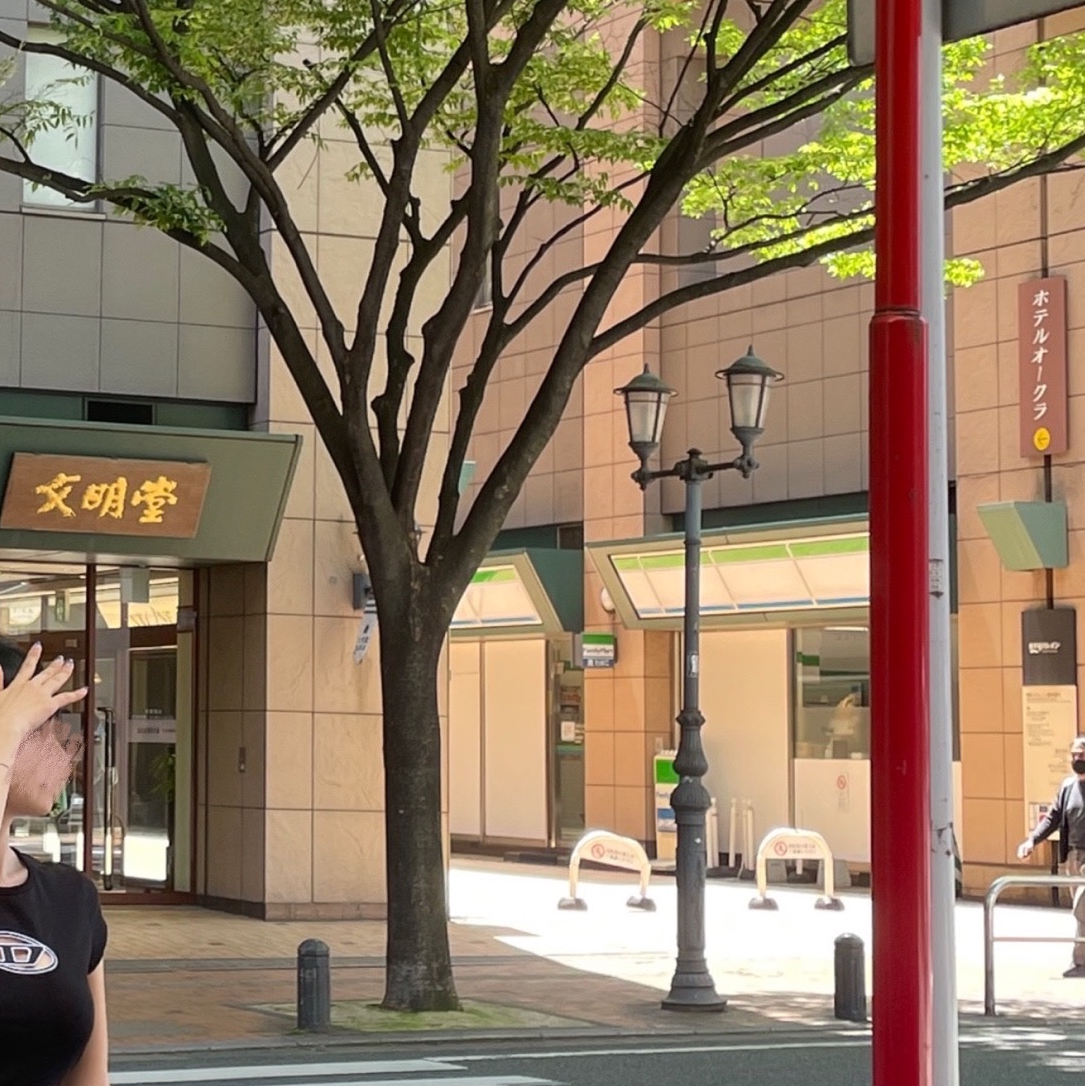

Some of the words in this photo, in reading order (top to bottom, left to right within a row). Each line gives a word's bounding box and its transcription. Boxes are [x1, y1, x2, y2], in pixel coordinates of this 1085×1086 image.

[1030, 289, 1050, 421] ホテルオークラ
[34, 472, 179, 524] 文明堂
